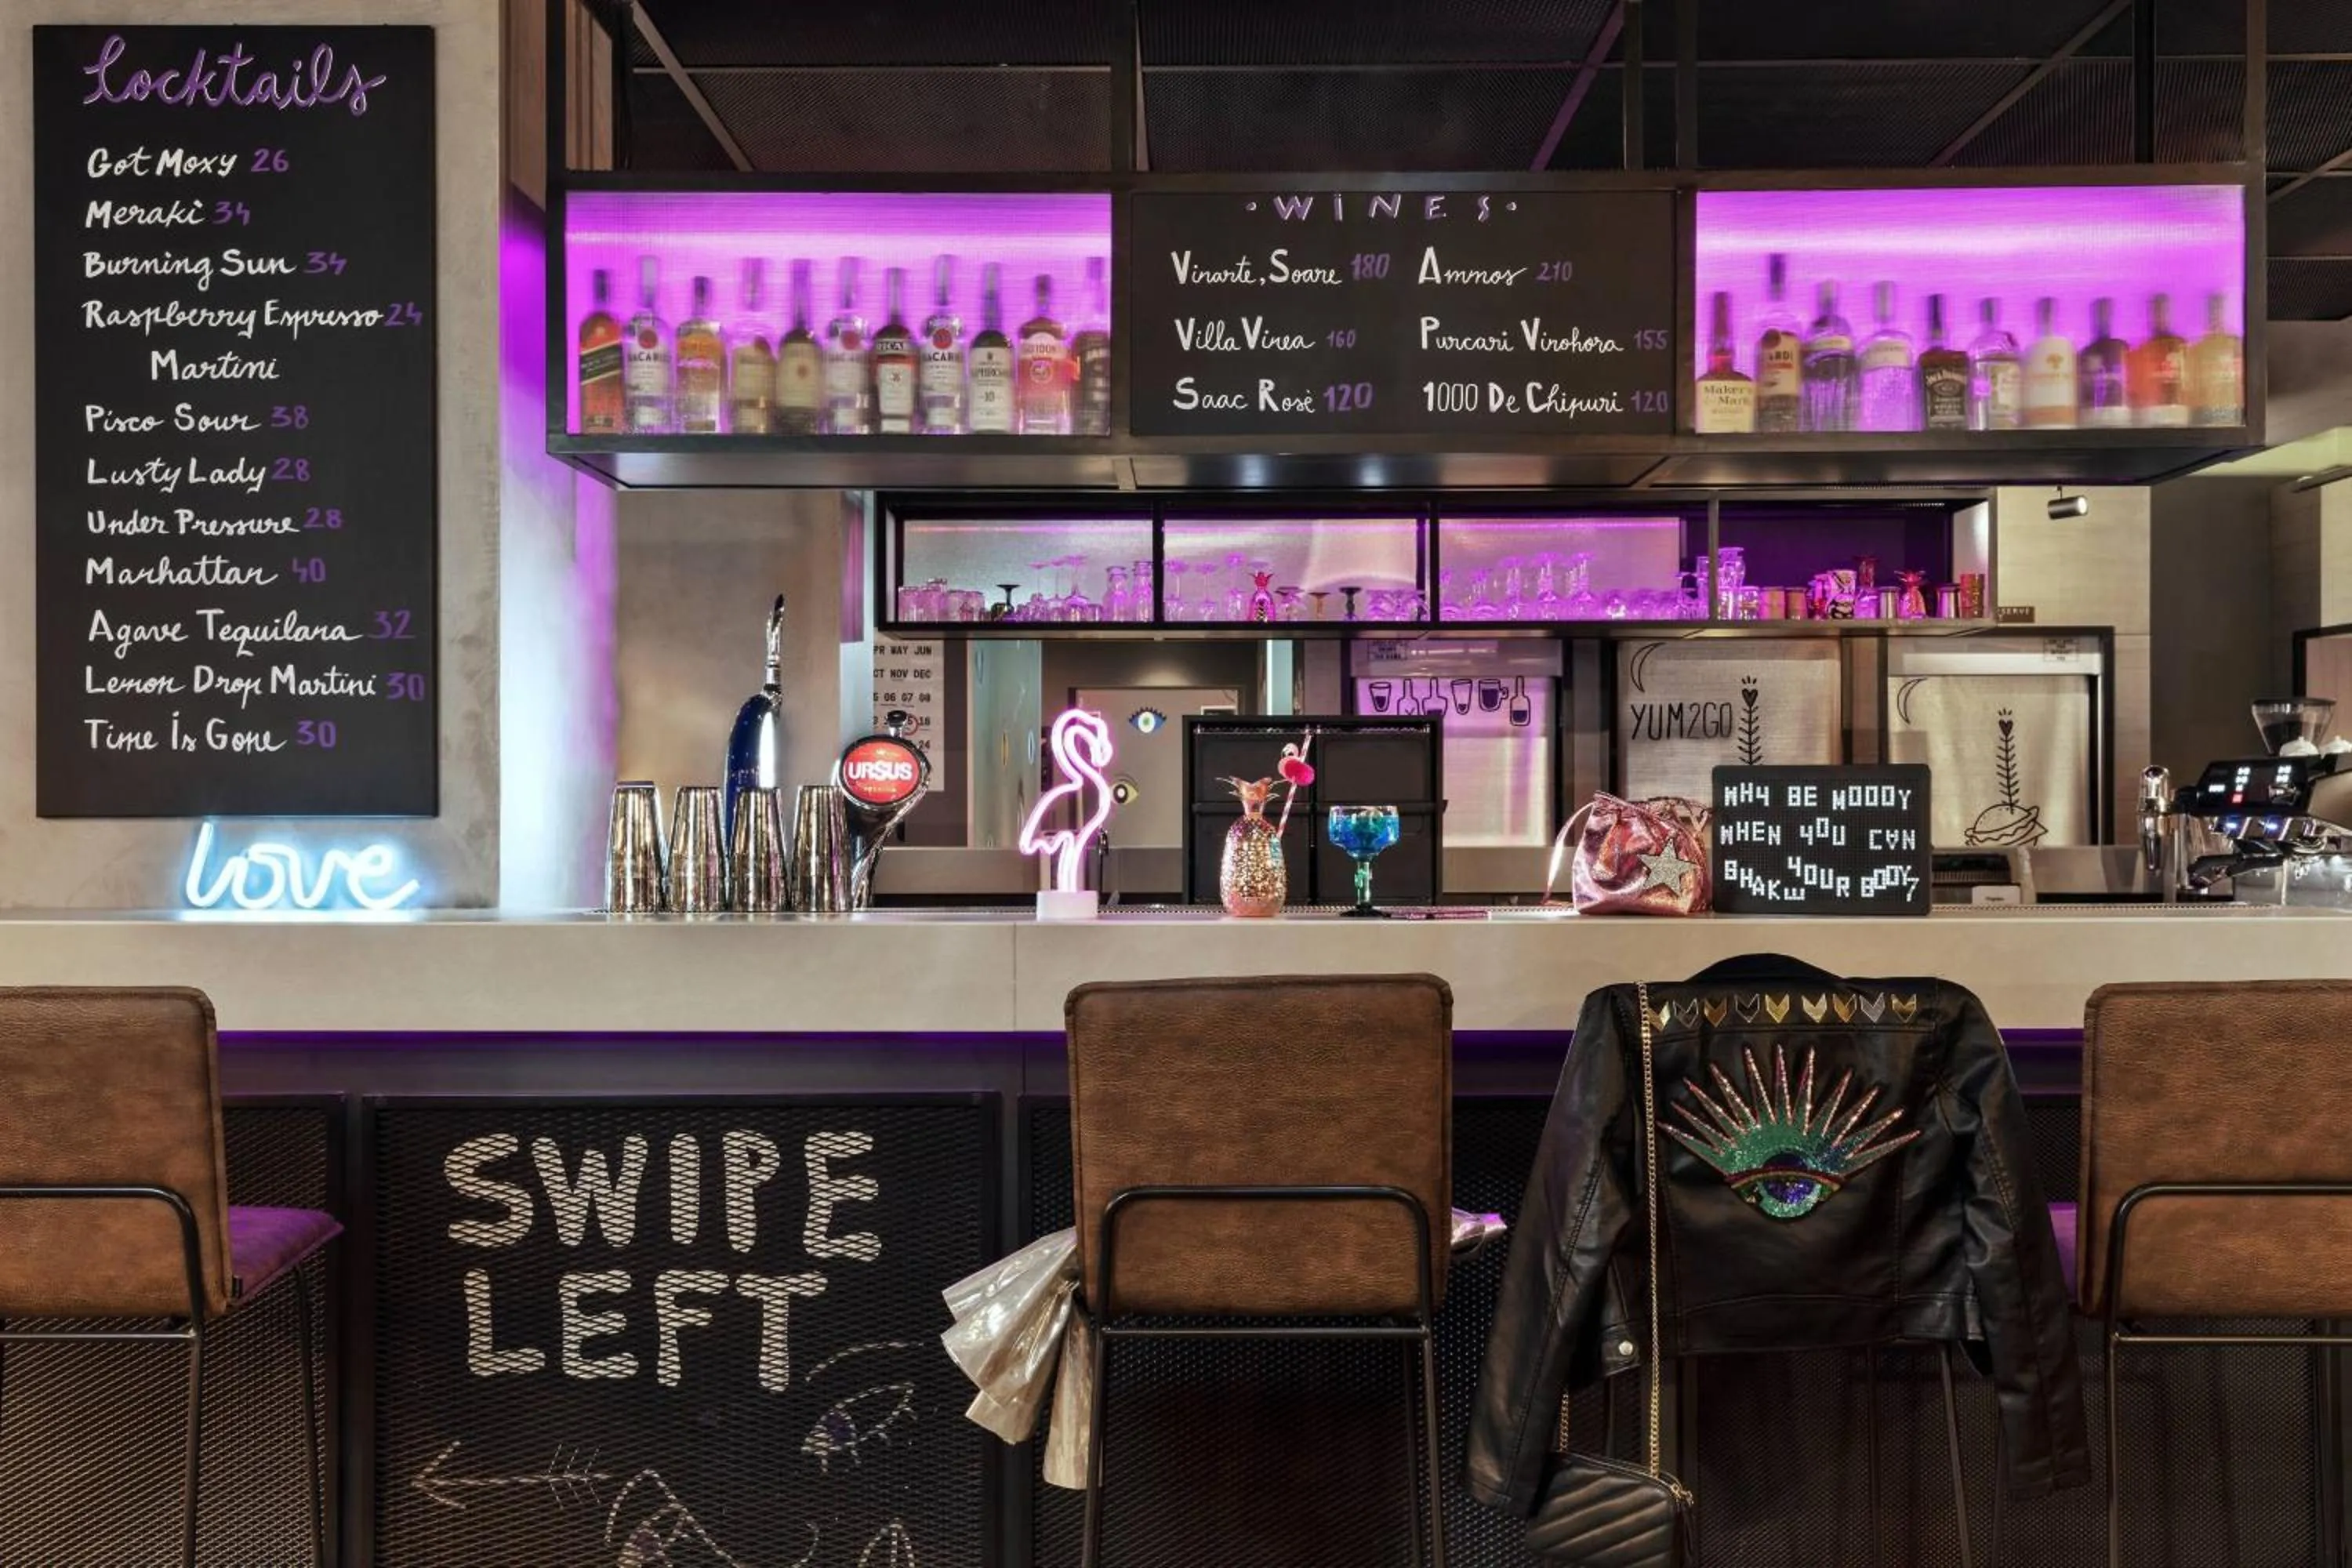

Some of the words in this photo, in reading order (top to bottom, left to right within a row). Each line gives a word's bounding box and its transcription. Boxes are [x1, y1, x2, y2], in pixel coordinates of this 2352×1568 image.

[83, 36, 387, 115] Cocktails
[88, 147, 151, 178] Got
[155, 148, 238, 177] Moxy
[251, 149, 289, 172] 26
[85, 200, 204, 228] Meraki
[215, 201, 249, 225] 34
[83, 252, 213, 291] Burning
[220, 249, 296, 276] Sun
[302, 252, 347, 274] 34
[1269, 249, 1342, 284] Soare
[1351, 254, 1390, 280] 180
[1418, 246, 1526, 285] Ammos
[1537, 262, 1572, 281] 210
[82, 300, 256, 339] Raspberry
[265, 299, 383, 339] Espresso
[384, 304, 422, 326] 24
[1174, 318, 1240, 351] Villa
[1242, 316, 1316, 350] Vinea
[1327, 330, 1356, 348] 160
[1421, 317, 1513, 351] Purcari
[1635, 330, 1667, 349] 155
[151, 350, 279, 380] Martini
[1173, 377, 1247, 409] Saac
[1323, 380, 1372, 411] 120
[1424, 382, 1478, 412] 1000
[1489, 383, 1519, 412] De
[1631, 391, 1668, 412] 120
[86, 405, 164, 432] Pisco
[174, 403, 260, 432] Sour
[271, 405, 308, 428] 38
[88, 458, 181, 492] Lusty
[189, 457, 266, 493] Lady
[272, 458, 309, 481] 28
[88, 510, 169, 535] Under
[174, 509, 299, 535] Pressure
[304, 508, 343, 528] 28
[86, 555, 278, 585] Manhattan
[292, 558, 325, 583] 40
[89, 610, 188, 659] Agave
[196, 608, 362, 657] Tequilana
[368, 611, 416, 639] 32
[873, 646, 885, 655] PR
[891, 646, 909, 655] MAY
[914, 646, 932, 655] JUN
[86, 666, 185, 694] Lemon
[194, 665, 262, 709] Drop
[271, 665, 376, 695] Martini
[387, 673, 424, 700] 30
[891, 669, 909, 678] NOV
[913, 669, 931, 678] DEC
[884, 693, 896, 702] 06
[901, 693, 913, 702] 07
[85, 720, 158, 752] Time
[206, 718, 286, 753] Gone
[296, 720, 337, 749] 30
[1631, 702, 1733, 740] YUM2GO
[848, 760, 913, 781] URSUS
[1788, 786, 1817, 806] BE
[1721, 822, 1780, 845] WHEN
[445, 1129, 881, 1261] SWIPE
[464, 1269, 828, 1391] LEFT
